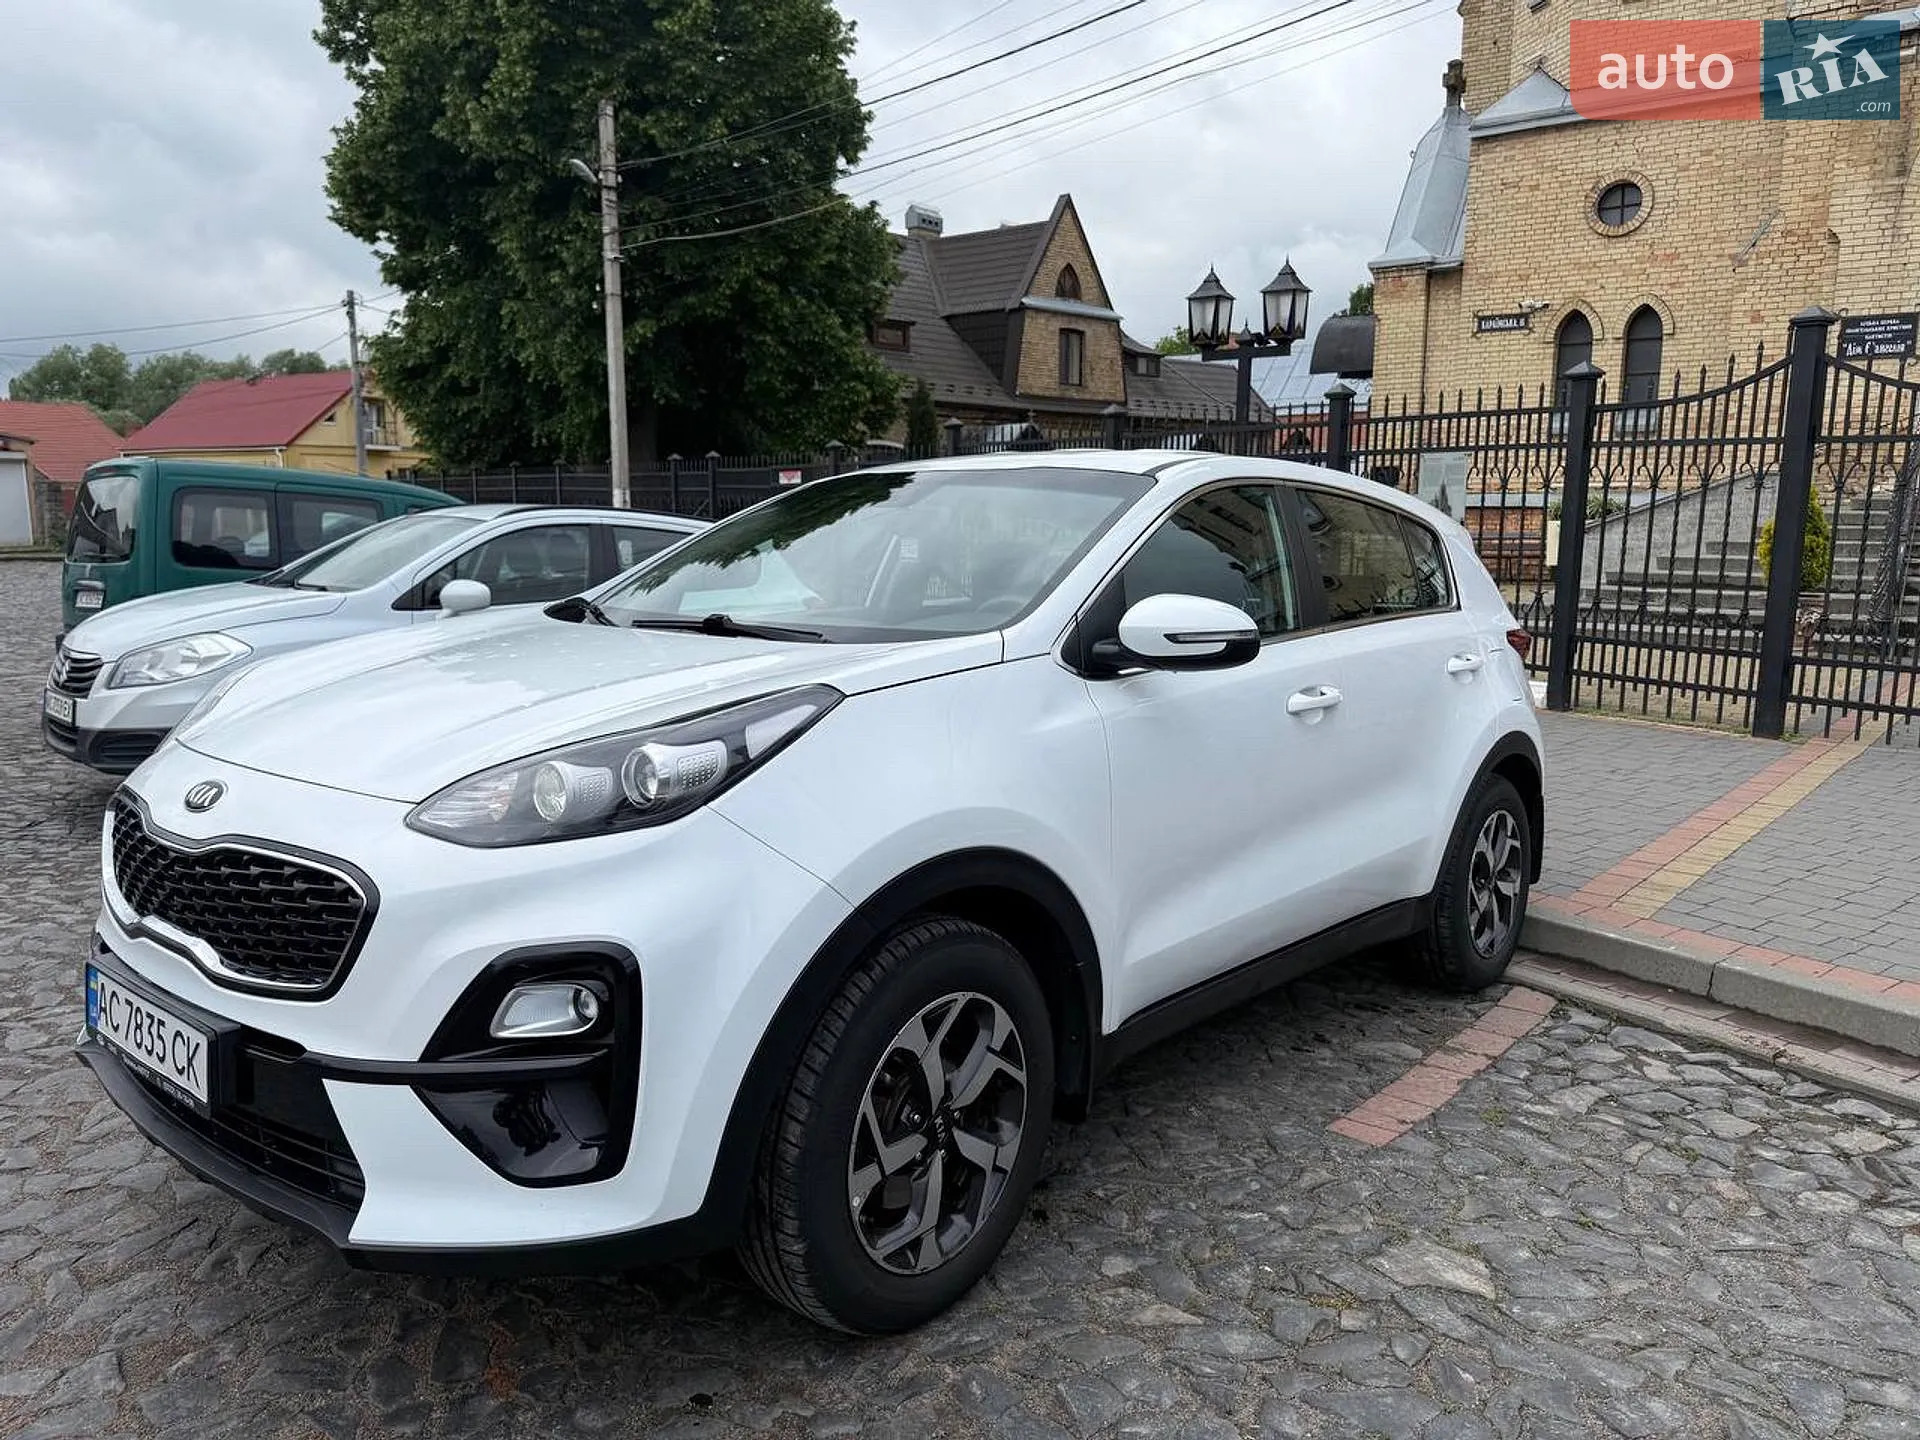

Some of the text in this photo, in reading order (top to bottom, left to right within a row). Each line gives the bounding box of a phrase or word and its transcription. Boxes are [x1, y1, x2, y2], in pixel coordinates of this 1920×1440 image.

[99, 982, 120, 1033] AC
[124, 998, 166, 1064] 7835
[172, 1029, 200, 1088] CK
